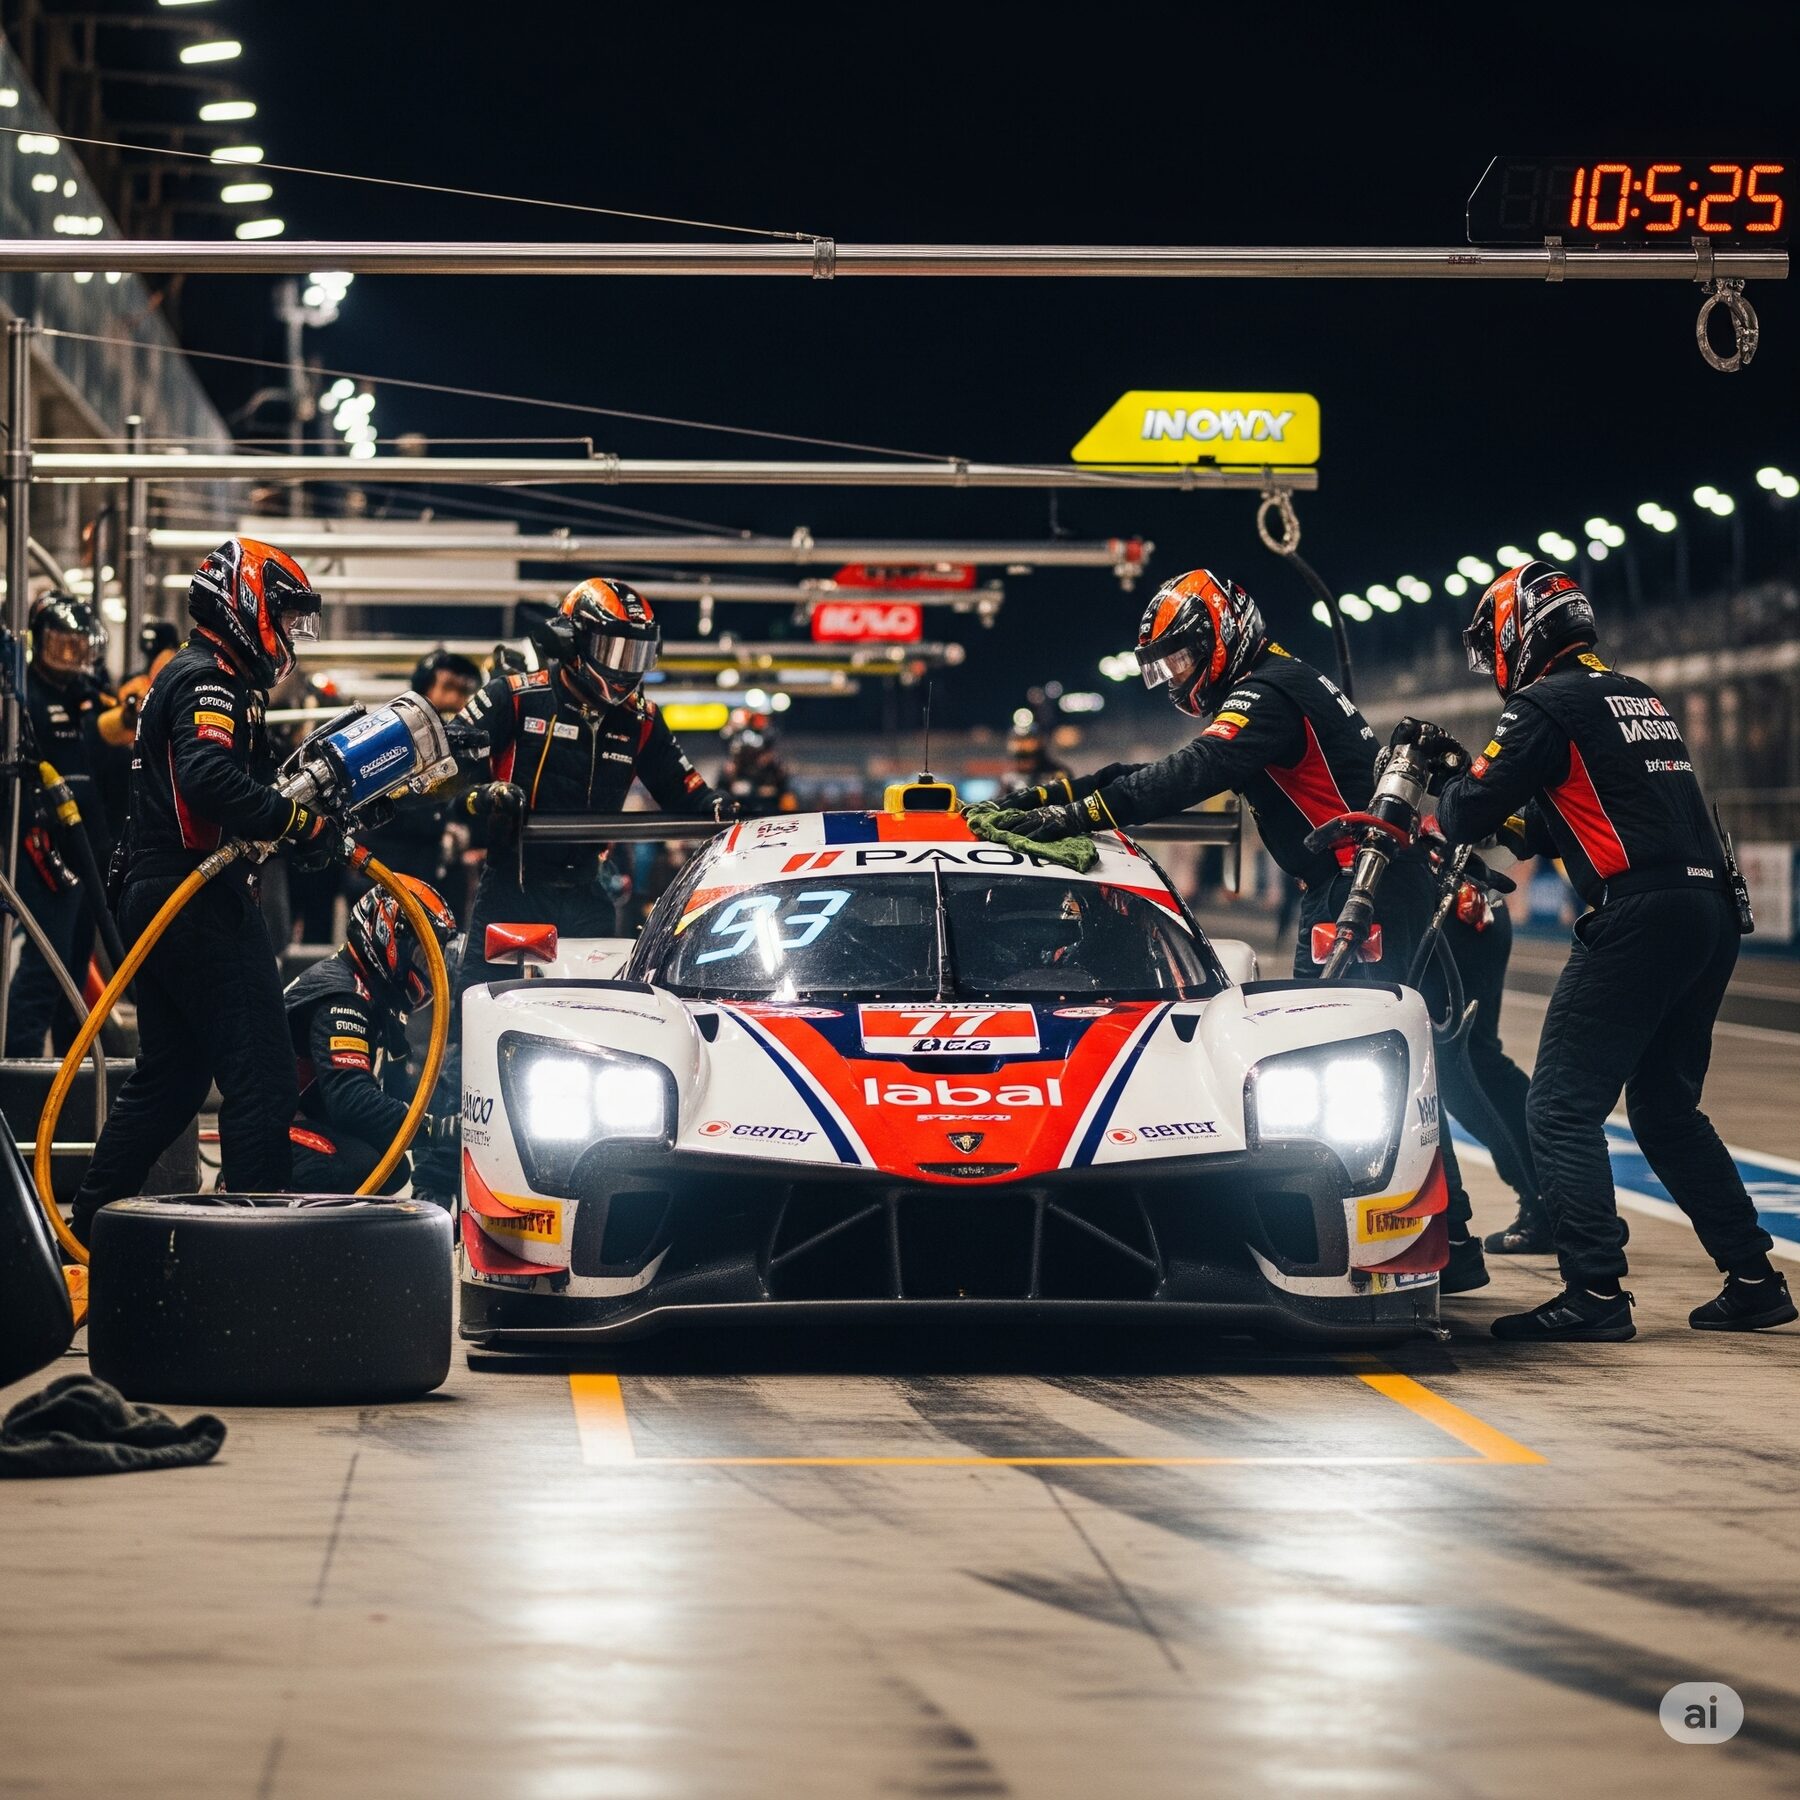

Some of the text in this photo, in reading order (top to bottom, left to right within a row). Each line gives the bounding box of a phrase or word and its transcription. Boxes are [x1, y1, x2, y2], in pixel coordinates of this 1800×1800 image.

[1570, 164, 1784, 231] 10:5:25
[696, 890, 852, 965] 93
[900, 1011, 997, 1036] 77
[864, 1077, 1063, 1107] labal
